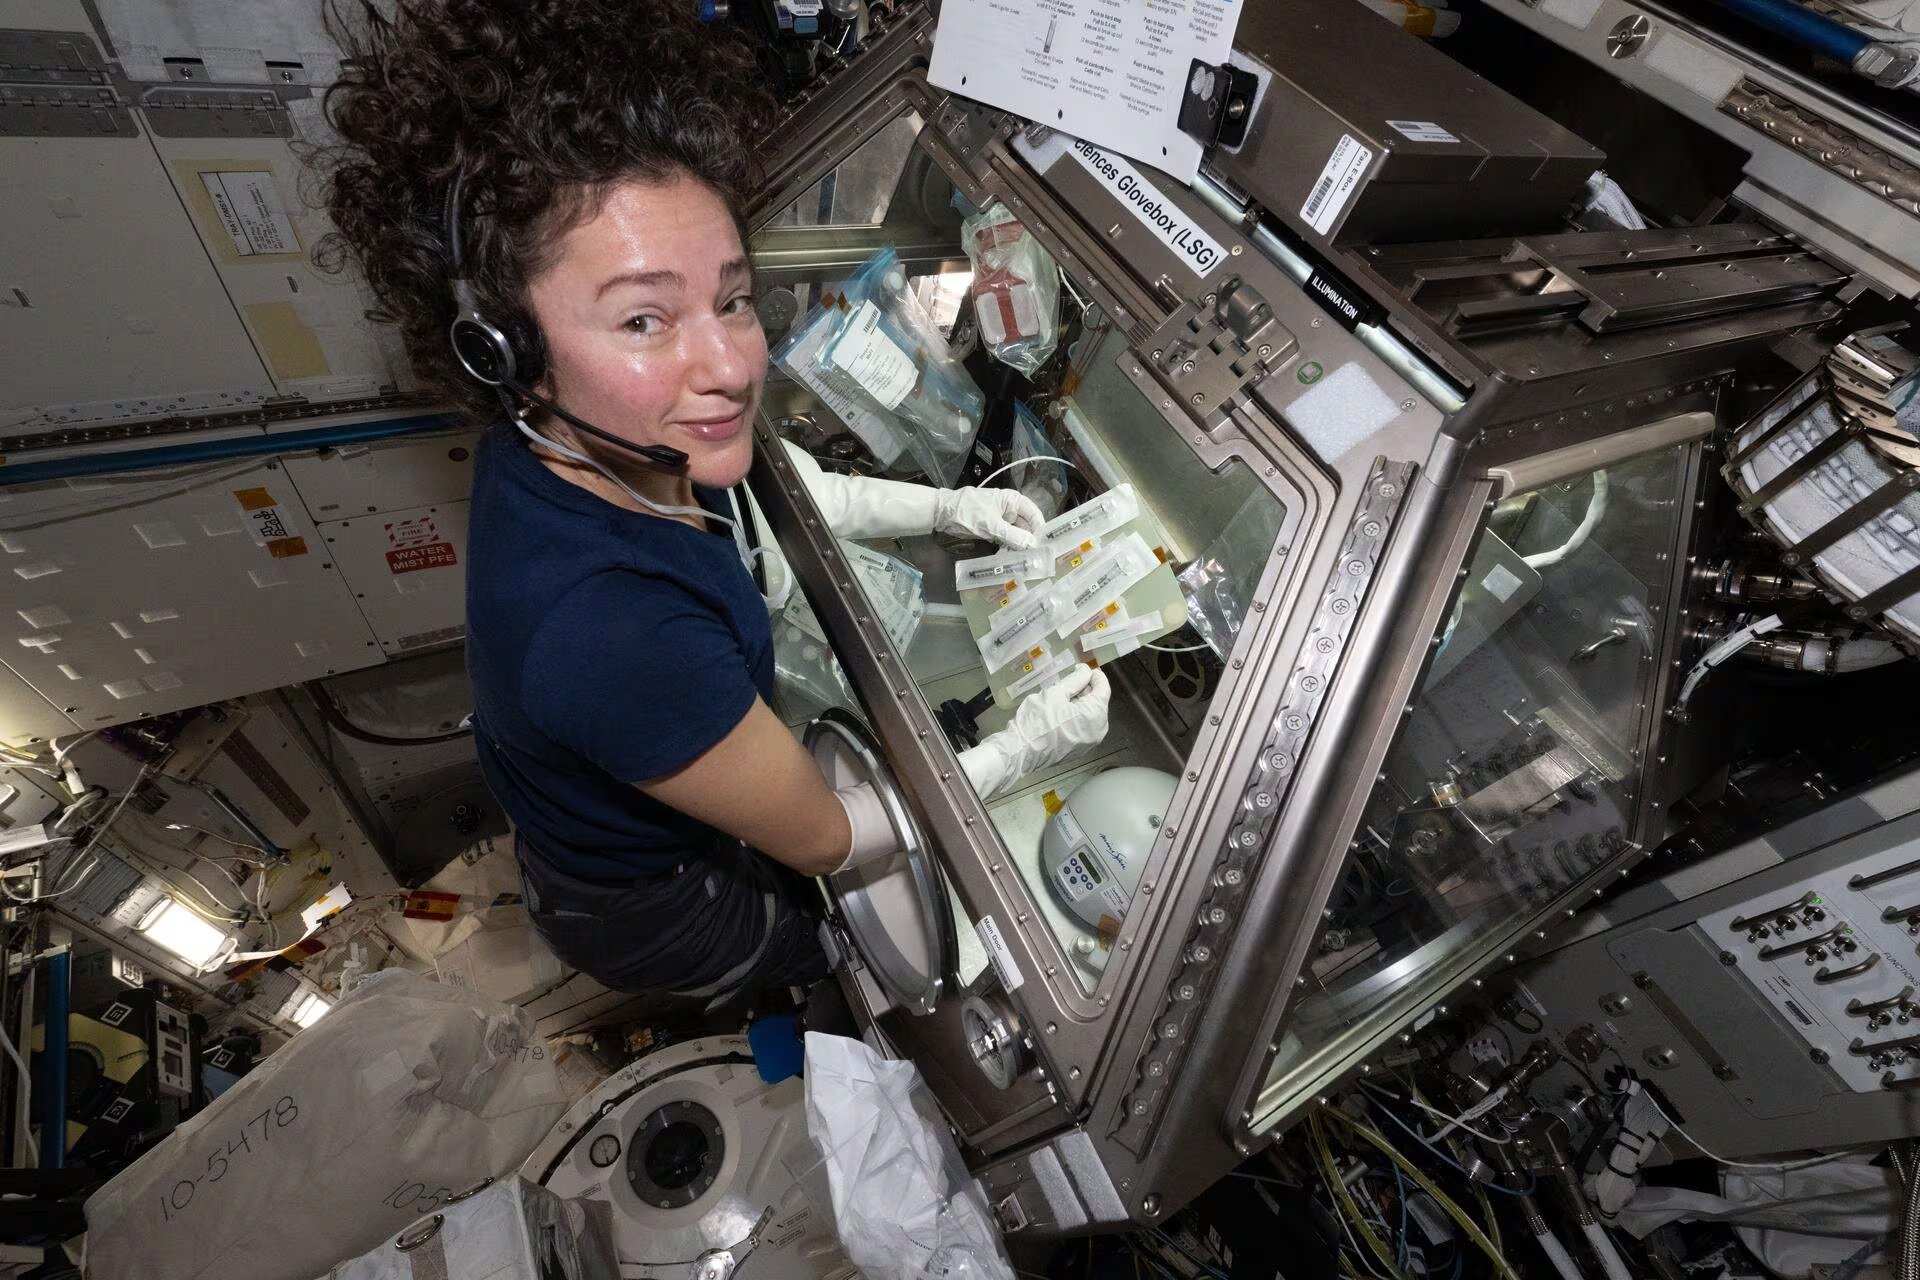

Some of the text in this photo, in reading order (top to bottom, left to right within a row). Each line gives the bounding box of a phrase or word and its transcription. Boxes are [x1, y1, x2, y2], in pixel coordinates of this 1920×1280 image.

[1342, 150, 1369, 192] Fan E-Box
[1074, 138, 1119, 180] ciences
[1118, 175, 1177, 234] Glovebox
[1171, 228, 1218, 272] (LSG)
[1311, 275, 1359, 319] ILLUMINATION
[393, 553, 454, 570] MIST PFE
[395, 545, 446, 560] WATER
[984, 918, 1003, 950] Main Door
[1883, 951, 1920, 986] FUNCTIONS
